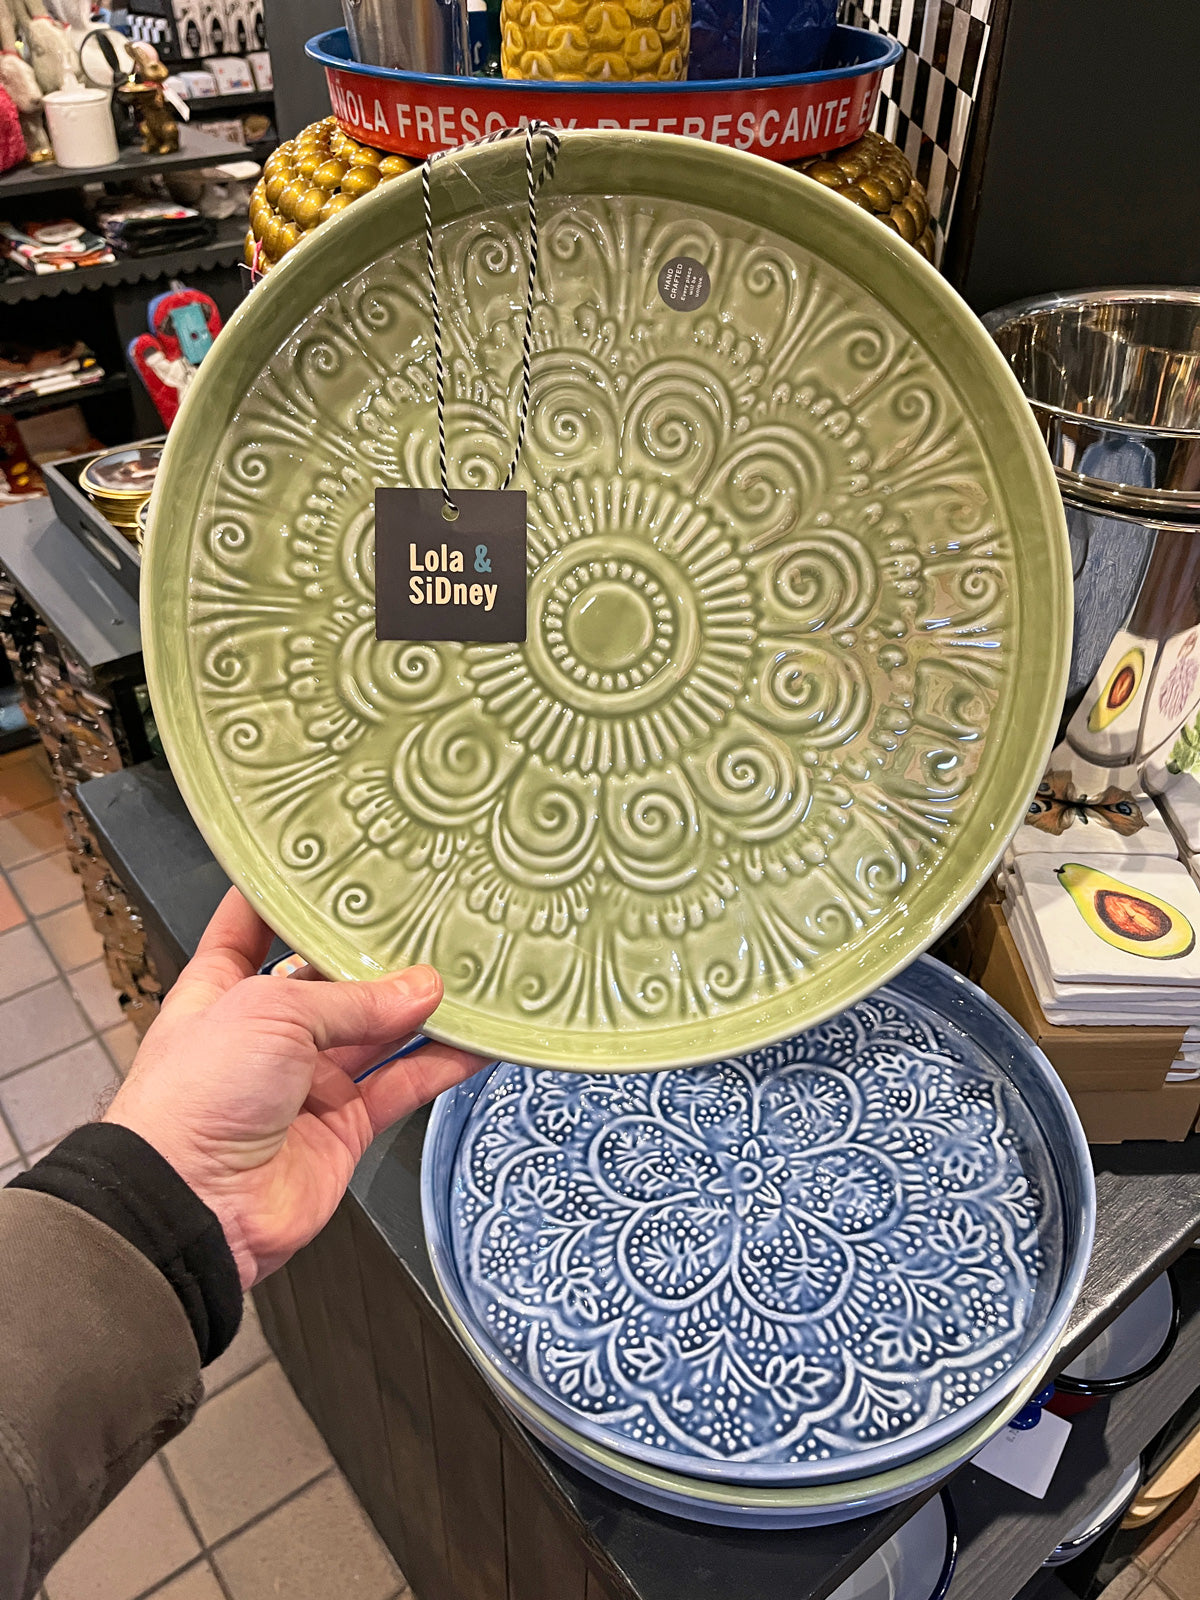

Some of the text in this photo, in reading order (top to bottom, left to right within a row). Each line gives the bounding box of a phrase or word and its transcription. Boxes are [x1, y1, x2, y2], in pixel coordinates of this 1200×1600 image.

[664, 268, 674, 290] HAND
[670, 263, 683, 299] CRAFTED
[409, 543, 492, 573] Lola &
[408, 576, 498, 612] SiDney
